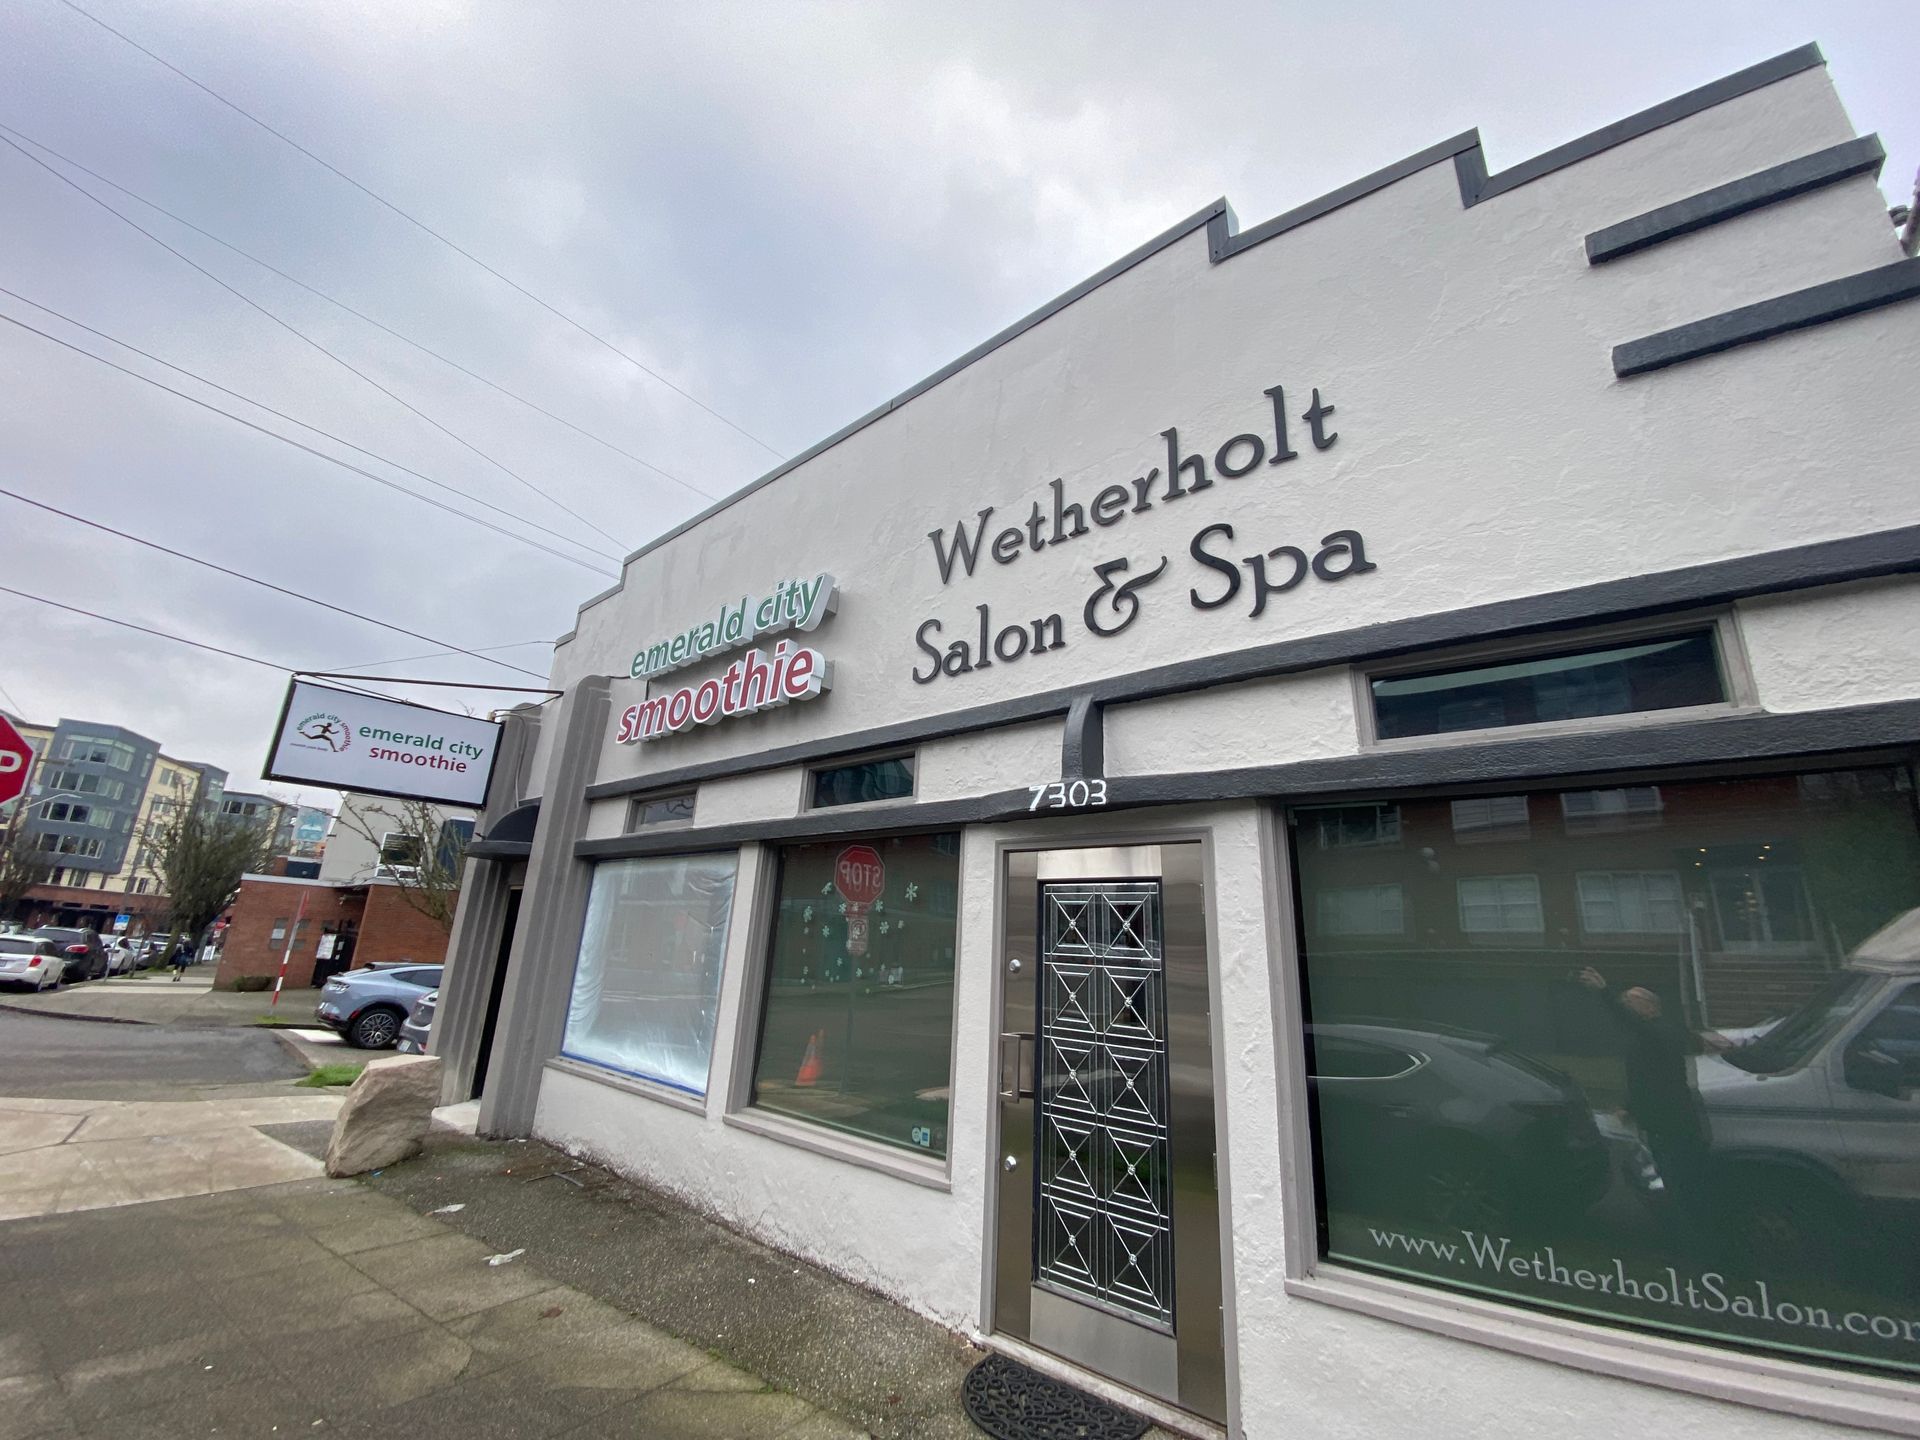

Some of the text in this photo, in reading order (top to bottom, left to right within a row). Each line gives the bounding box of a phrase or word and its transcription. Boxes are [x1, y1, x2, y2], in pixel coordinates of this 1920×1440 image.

[928, 384, 1339, 585] Wetherholt
[630, 573, 828, 680] emerald city
[912, 523, 1377, 685] Salon & Spa
[297, 713, 326, 731] emerald
[616, 638, 815, 744] smoothie
[359, 726, 484, 760] emerald city
[368, 747, 467, 773] smoothie
[1028, 779, 1107, 812] 7303
